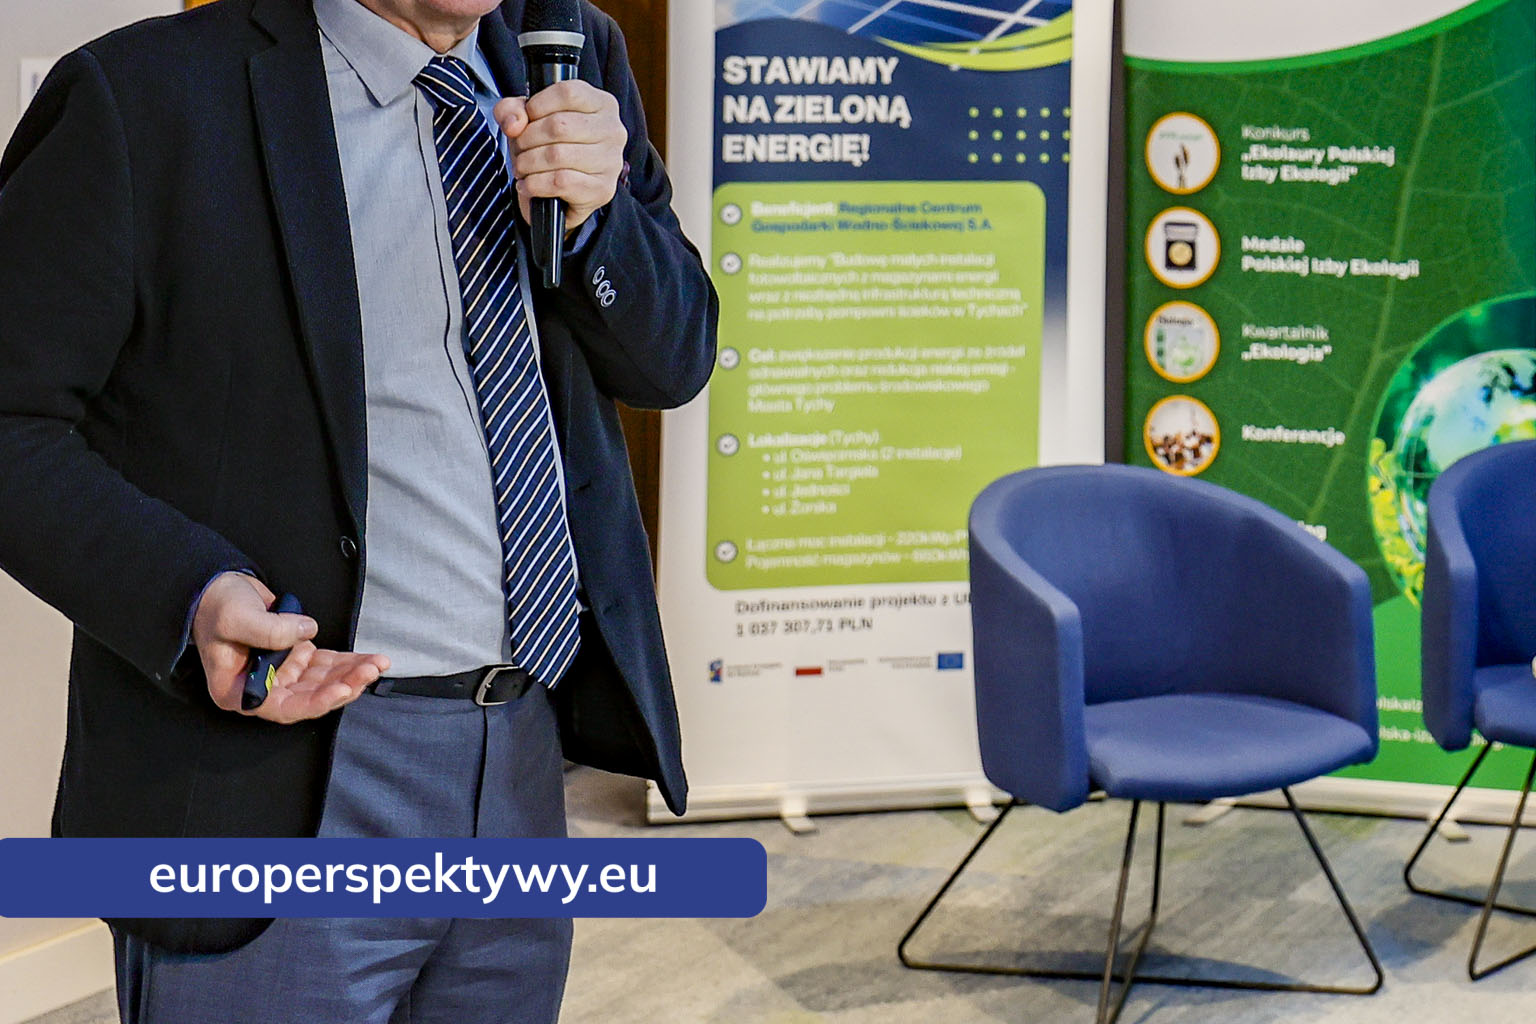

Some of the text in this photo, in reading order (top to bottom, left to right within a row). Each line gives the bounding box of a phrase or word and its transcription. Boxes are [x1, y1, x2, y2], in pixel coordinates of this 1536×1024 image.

[722, 56, 900, 86] STAWIAMY
[722, 95, 912, 129] NA ZIELONĄ
[1241, 124, 1311, 143] Konkurs
[722, 133, 872, 167] ENERGIĘ!
[1327, 145, 1397, 168] Polskiej
[1241, 235, 1306, 254] Medale
[1241, 255, 1310, 277] Polskiej
[1349, 259, 1421, 281] Ekologii
[1241, 323, 1330, 342] Kwartalnik
[1241, 424, 1347, 448] Konferencje
